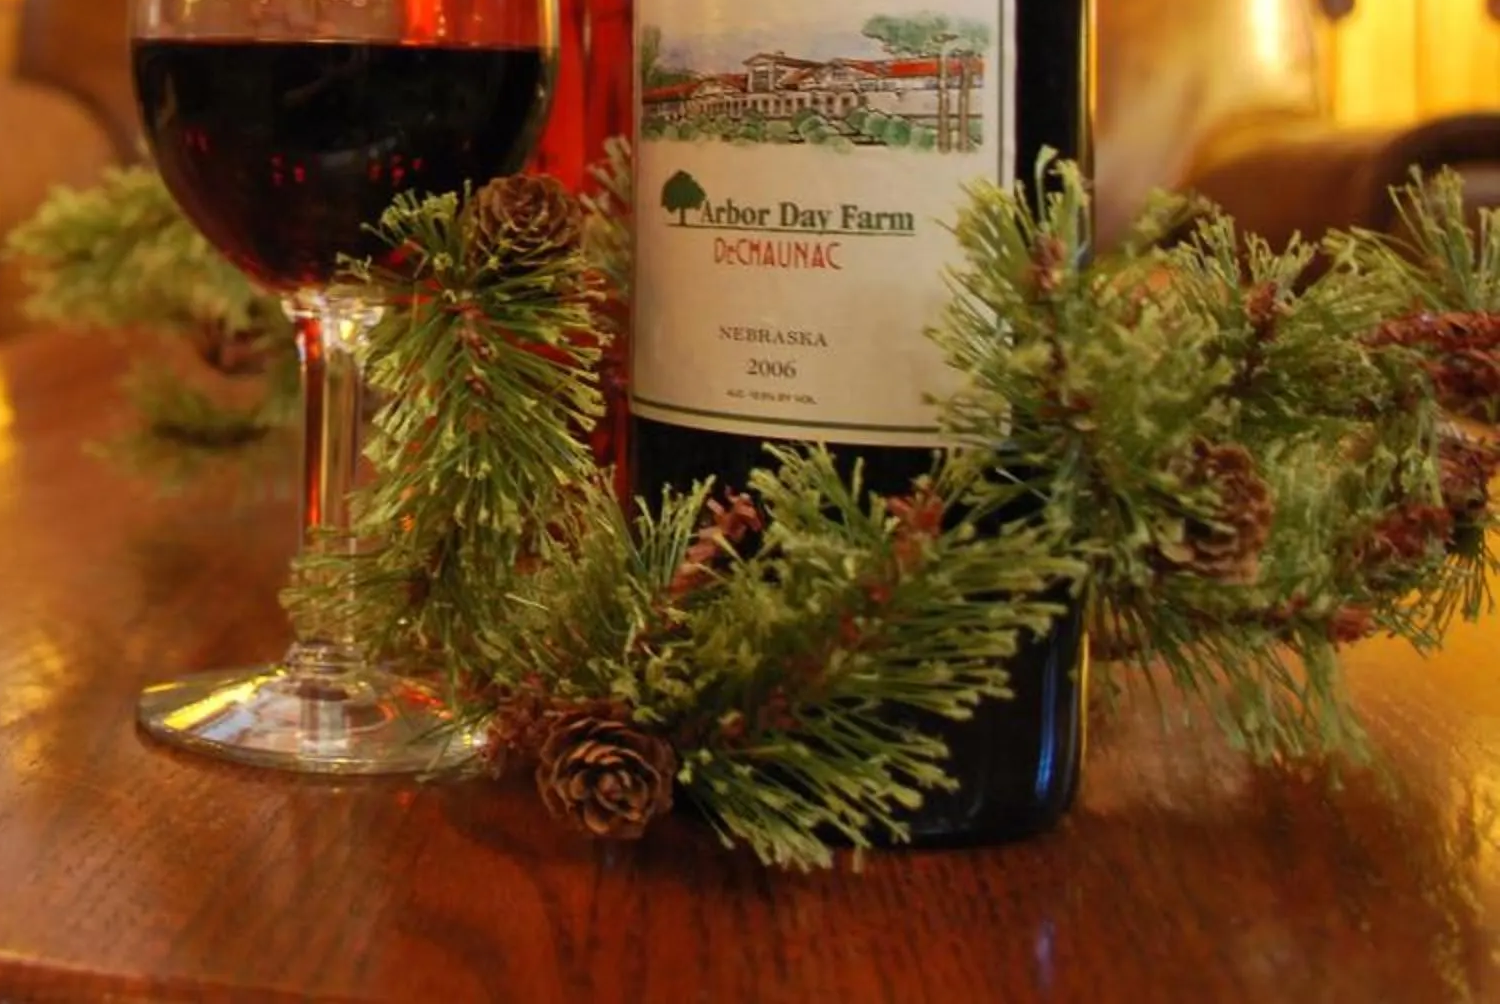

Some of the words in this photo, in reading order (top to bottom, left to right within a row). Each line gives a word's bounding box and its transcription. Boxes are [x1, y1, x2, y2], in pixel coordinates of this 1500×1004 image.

[700, 198, 771, 226] Arbor
[779, 202, 833, 235] Day
[840, 204, 915, 231] Farm
[719, 325, 828, 347] NEBRASKA
[746, 358, 797, 378] 2006
